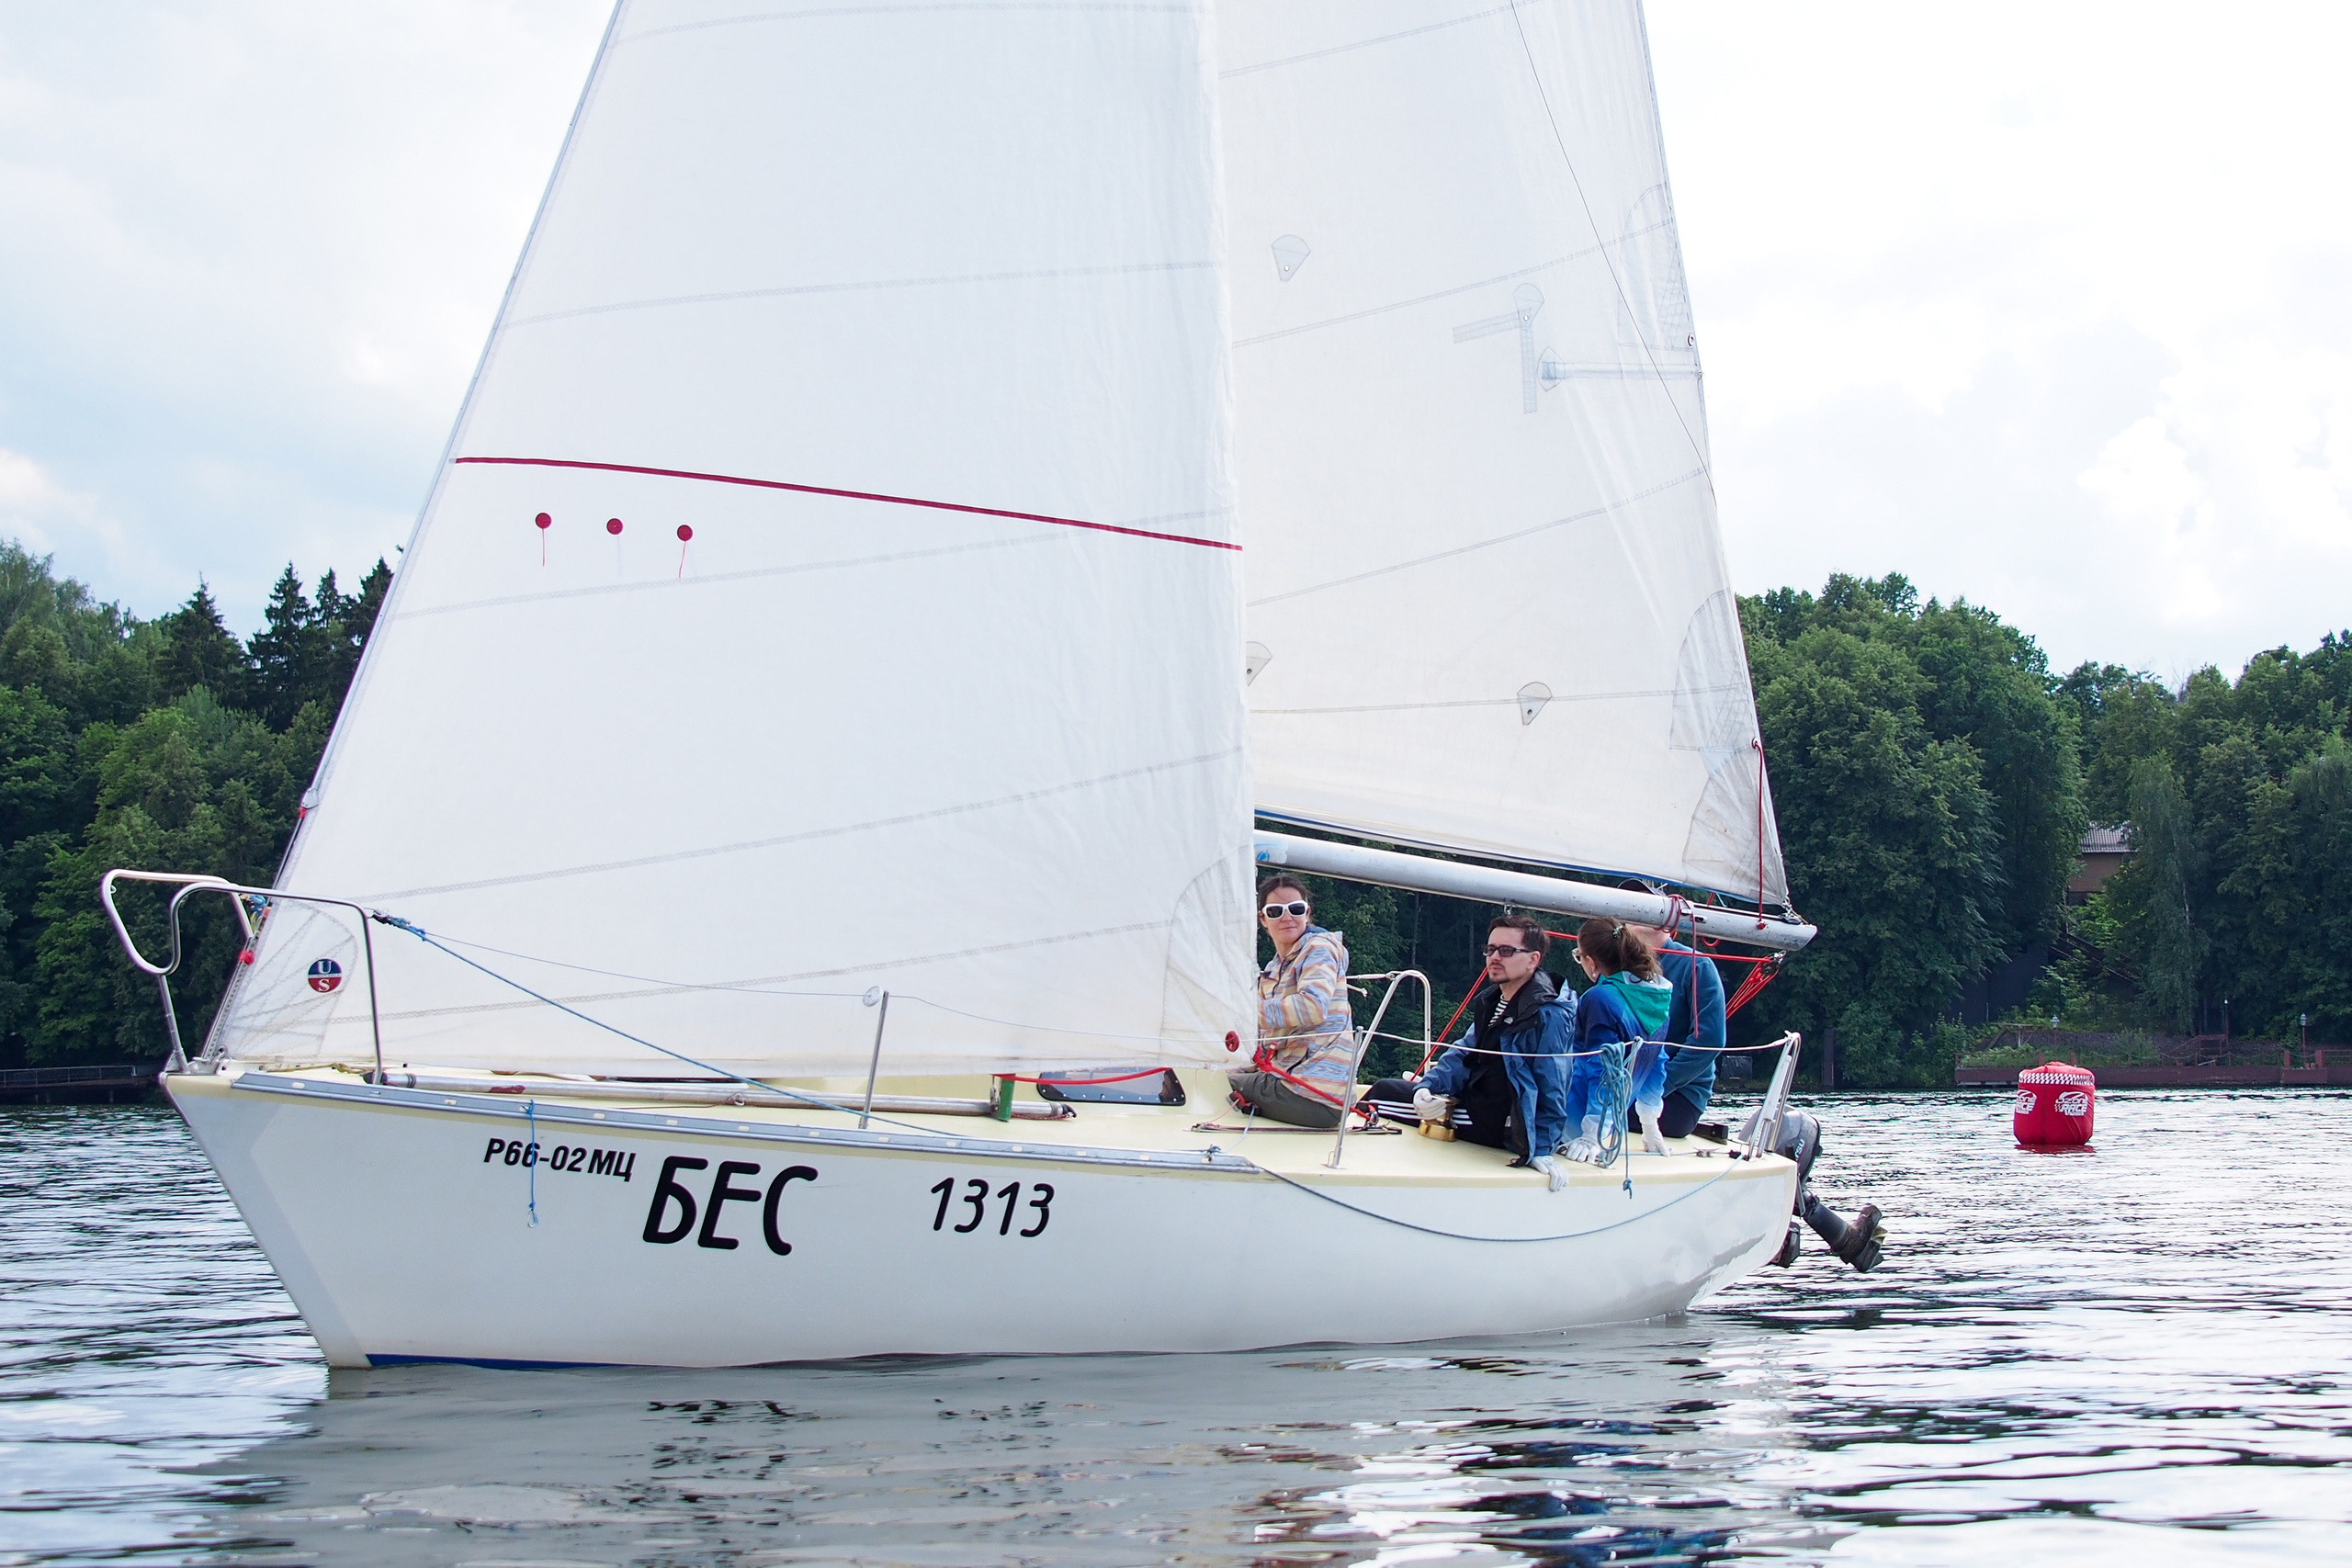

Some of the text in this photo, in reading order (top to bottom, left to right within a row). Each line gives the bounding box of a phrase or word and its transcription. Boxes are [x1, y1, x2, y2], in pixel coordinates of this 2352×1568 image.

[318, 961, 333, 975] U
[318, 978, 331, 992] S
[642, 1156, 819, 1257] БЕС
[931, 1177, 1055, 1238] 1313
